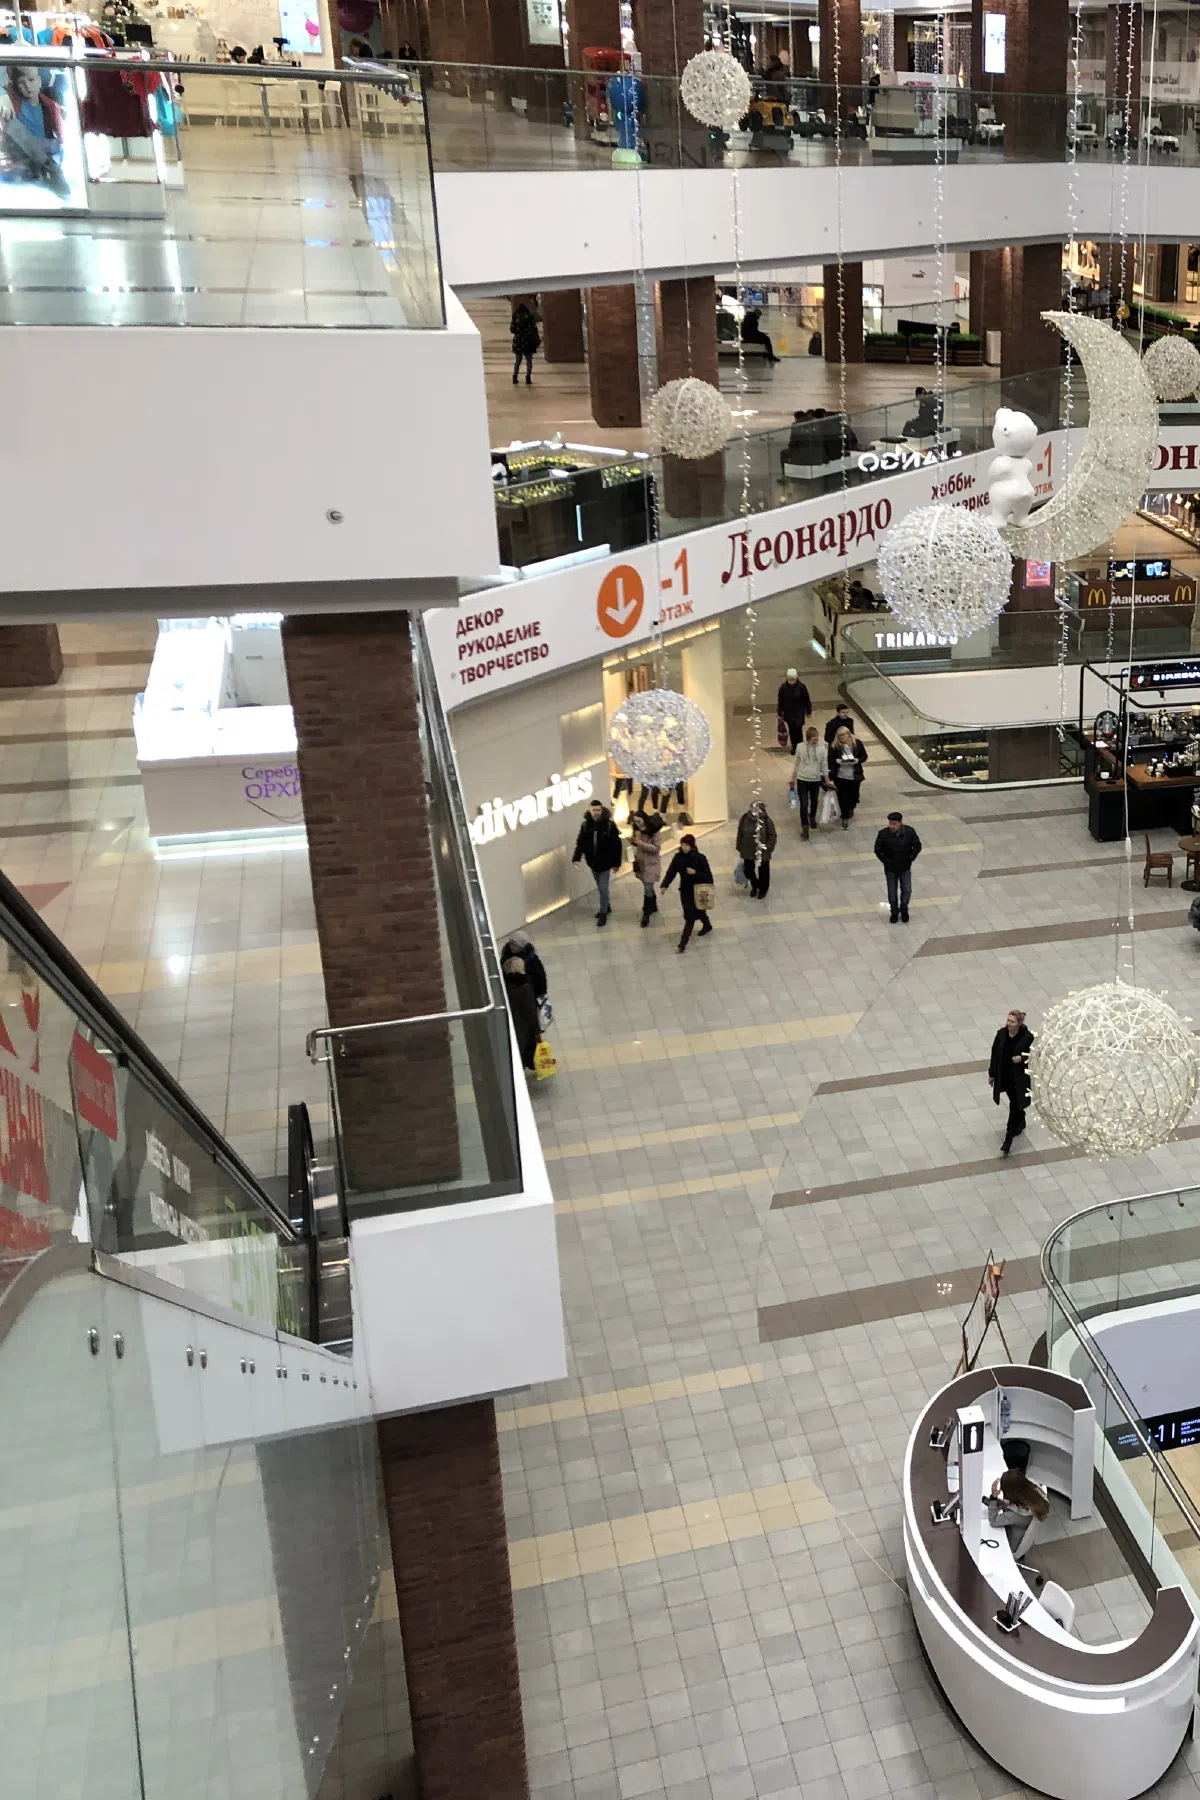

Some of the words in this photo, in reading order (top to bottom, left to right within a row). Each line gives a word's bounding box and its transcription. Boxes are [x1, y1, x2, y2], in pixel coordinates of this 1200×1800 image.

[721, 497, 892, 584] Леонардо
[456, 607, 504, 639] ДЕКОР
[658, 600, 694, 625] этаж
[458, 620, 542, 661] РУКОДЕЛИЕ
[459, 642, 550, 686] ТВОРЧЕСТВО
[241, 766, 302, 784] Серебр
[245, 782, 302, 800] ОРХИ
